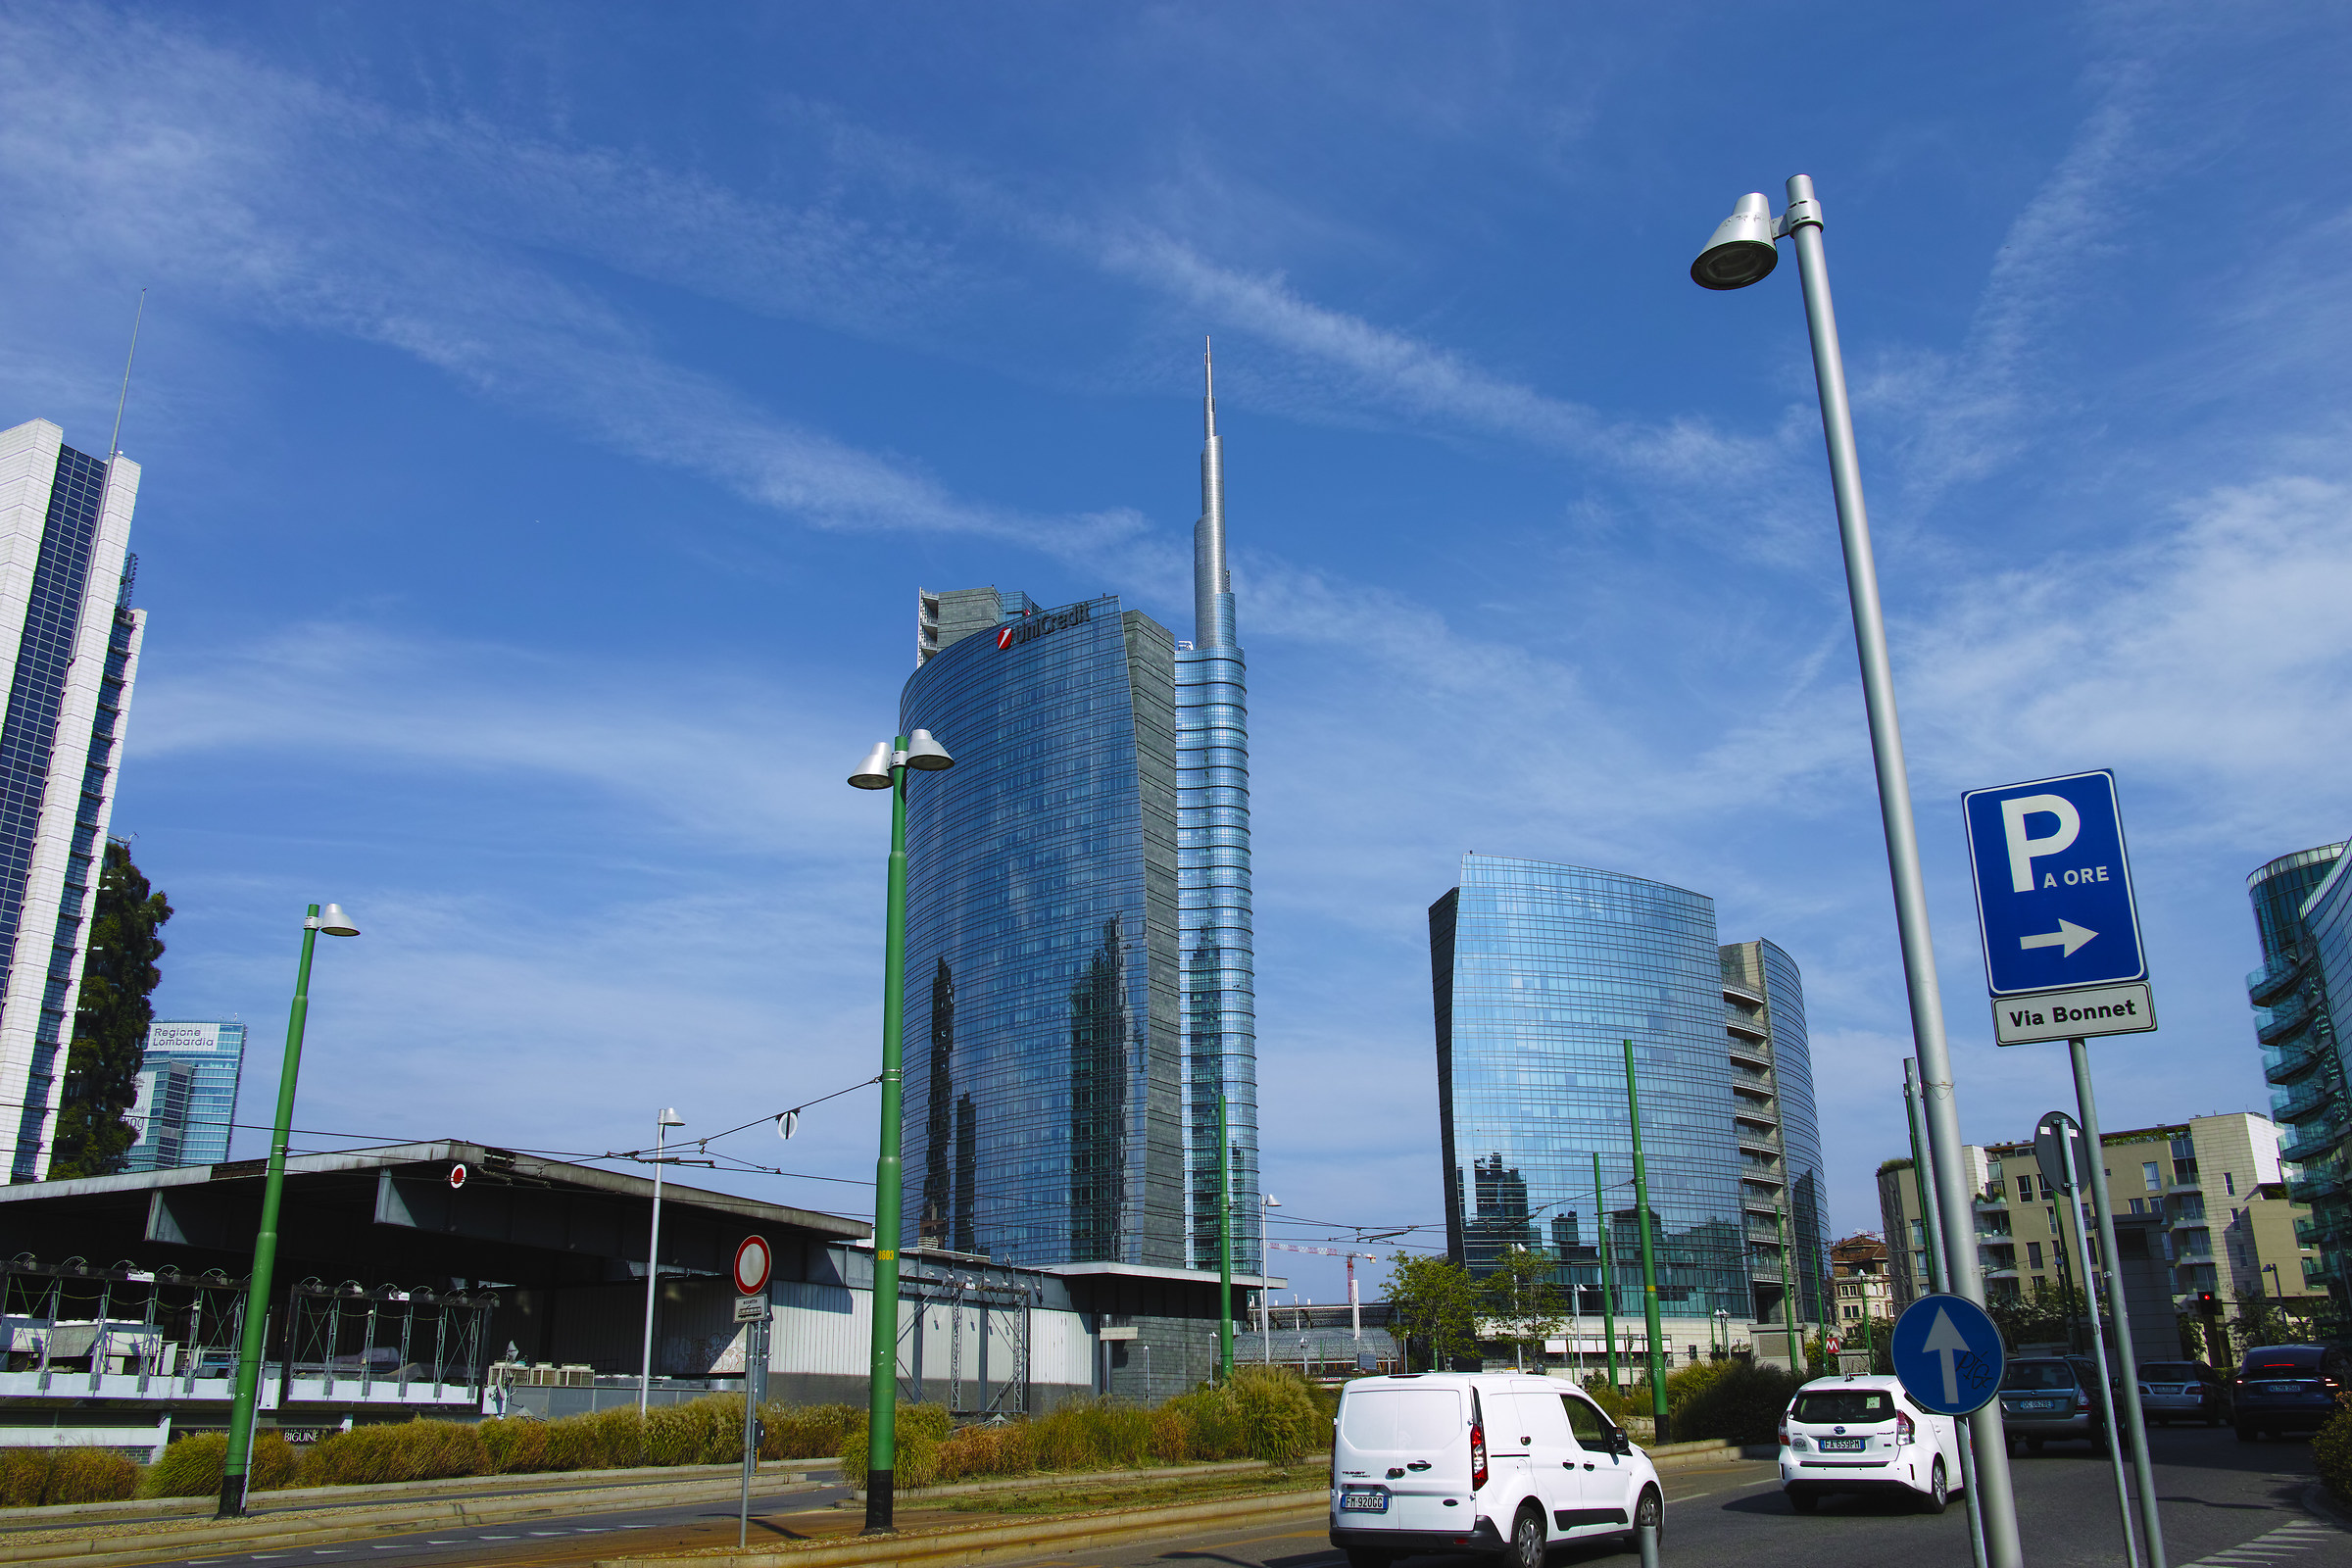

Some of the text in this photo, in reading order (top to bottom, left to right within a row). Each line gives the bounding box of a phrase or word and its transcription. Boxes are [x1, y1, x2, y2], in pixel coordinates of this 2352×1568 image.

[1013, 601, 1090, 644] UniCredit
[2000, 794, 2081, 893] P
[2043, 865, 2110, 889] A ORE
[2009, 999, 2136, 1027] Via Bonnet
[153, 1038, 215, 1047] Lombardia
[154, 1028, 202, 1039] Regione
[284, 1432, 318, 1443] BIGUINE
